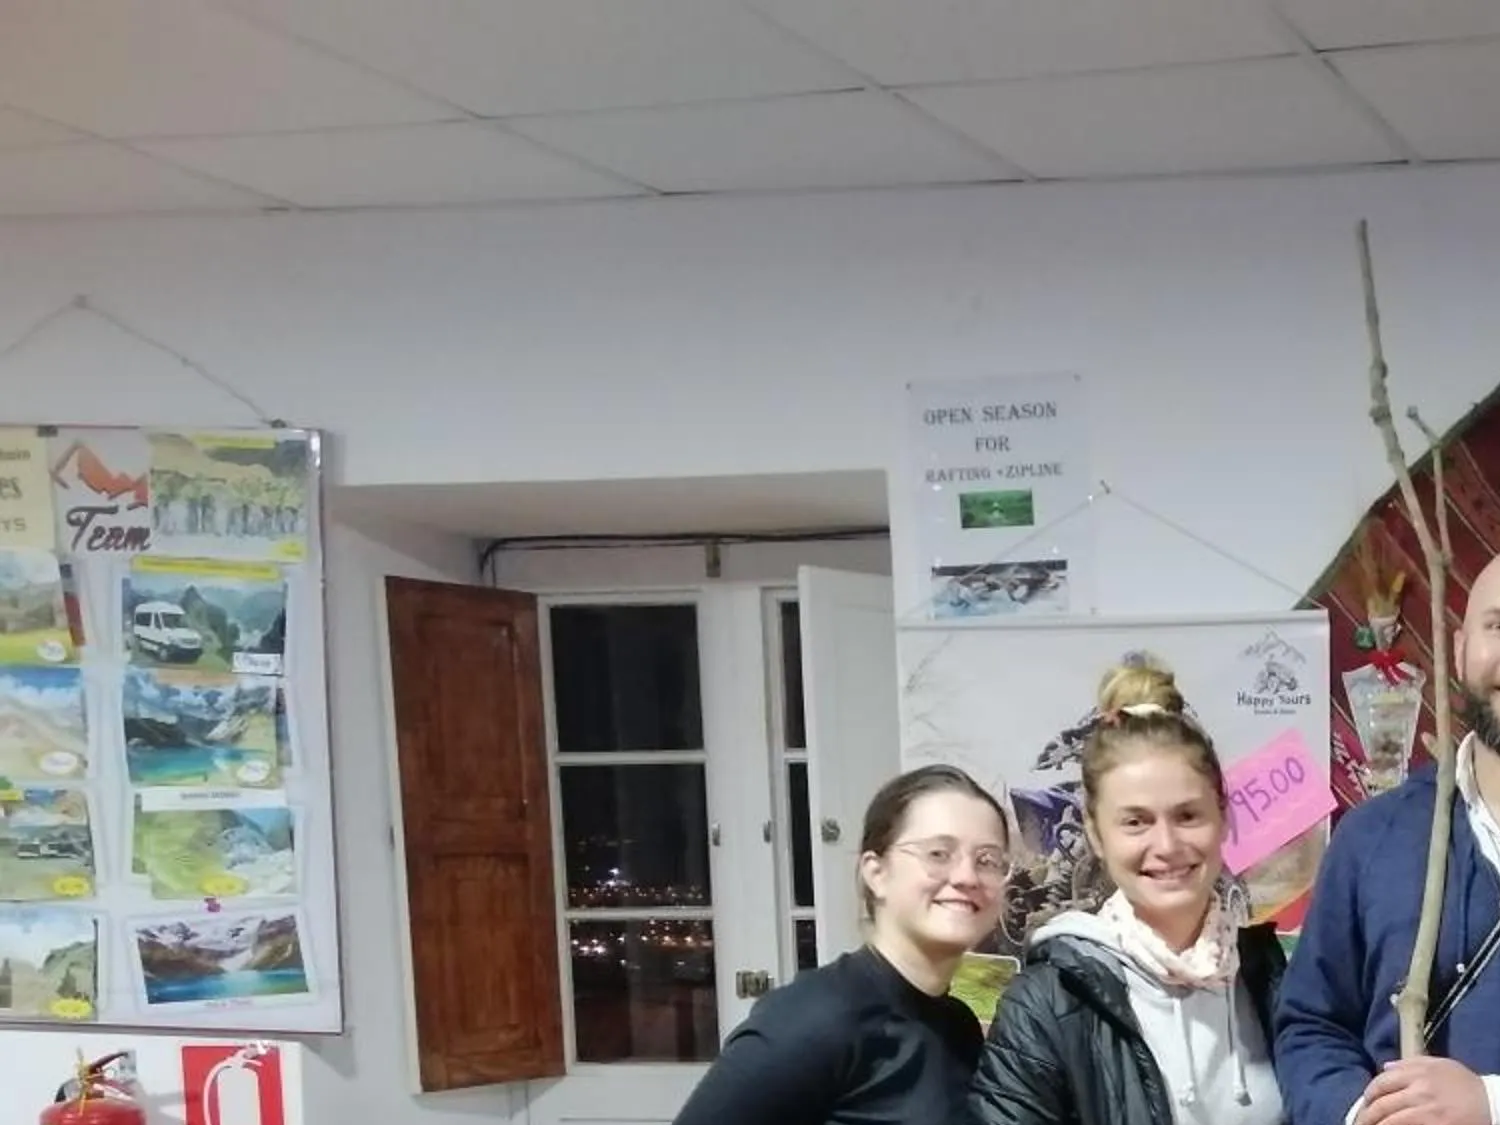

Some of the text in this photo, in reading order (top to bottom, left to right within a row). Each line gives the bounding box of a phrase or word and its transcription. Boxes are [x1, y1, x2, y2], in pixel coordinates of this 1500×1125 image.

[923, 401, 1057, 425] OPEN SEASON
[975, 436, 1010, 452] FOR
